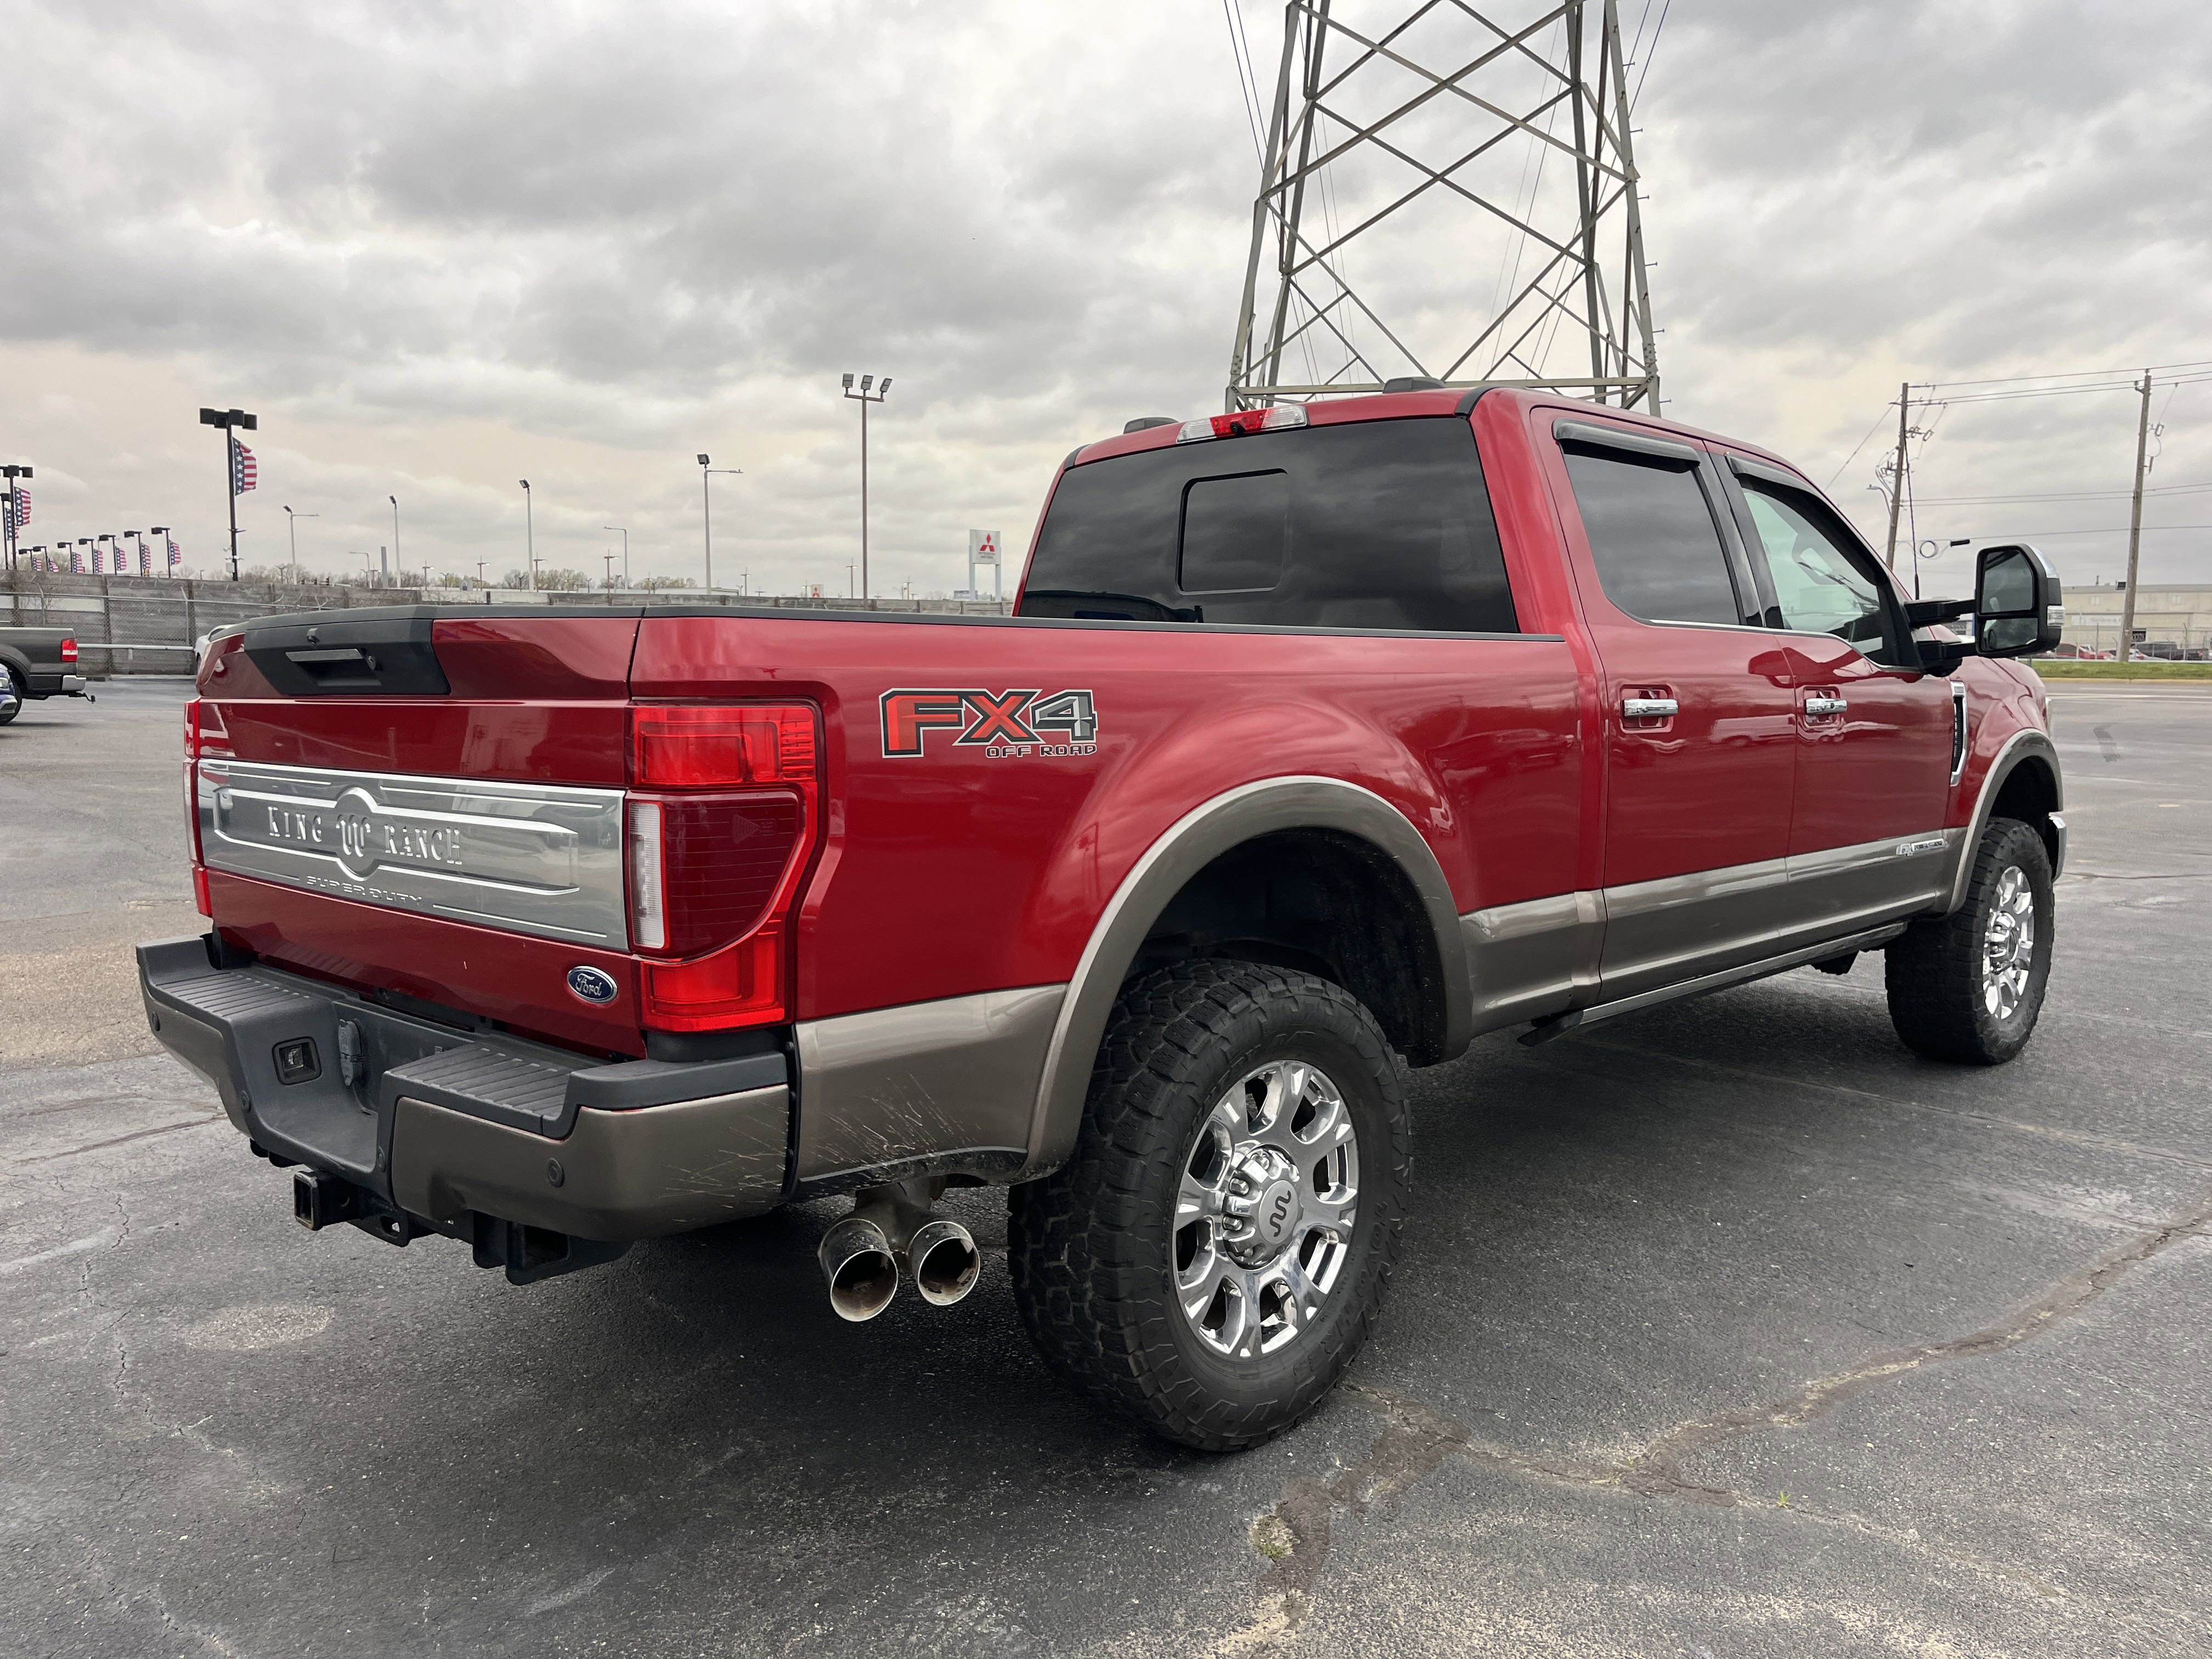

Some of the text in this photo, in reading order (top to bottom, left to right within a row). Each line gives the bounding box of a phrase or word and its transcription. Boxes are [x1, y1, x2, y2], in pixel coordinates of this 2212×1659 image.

[879, 688, 1098, 758] FX4
[986, 743, 1097, 758] OFF ROAD
[268, 806, 462, 865] KING RANCH
[307, 876, 422, 907] SUPER DUTY
[575, 973, 603, 996] Ford
